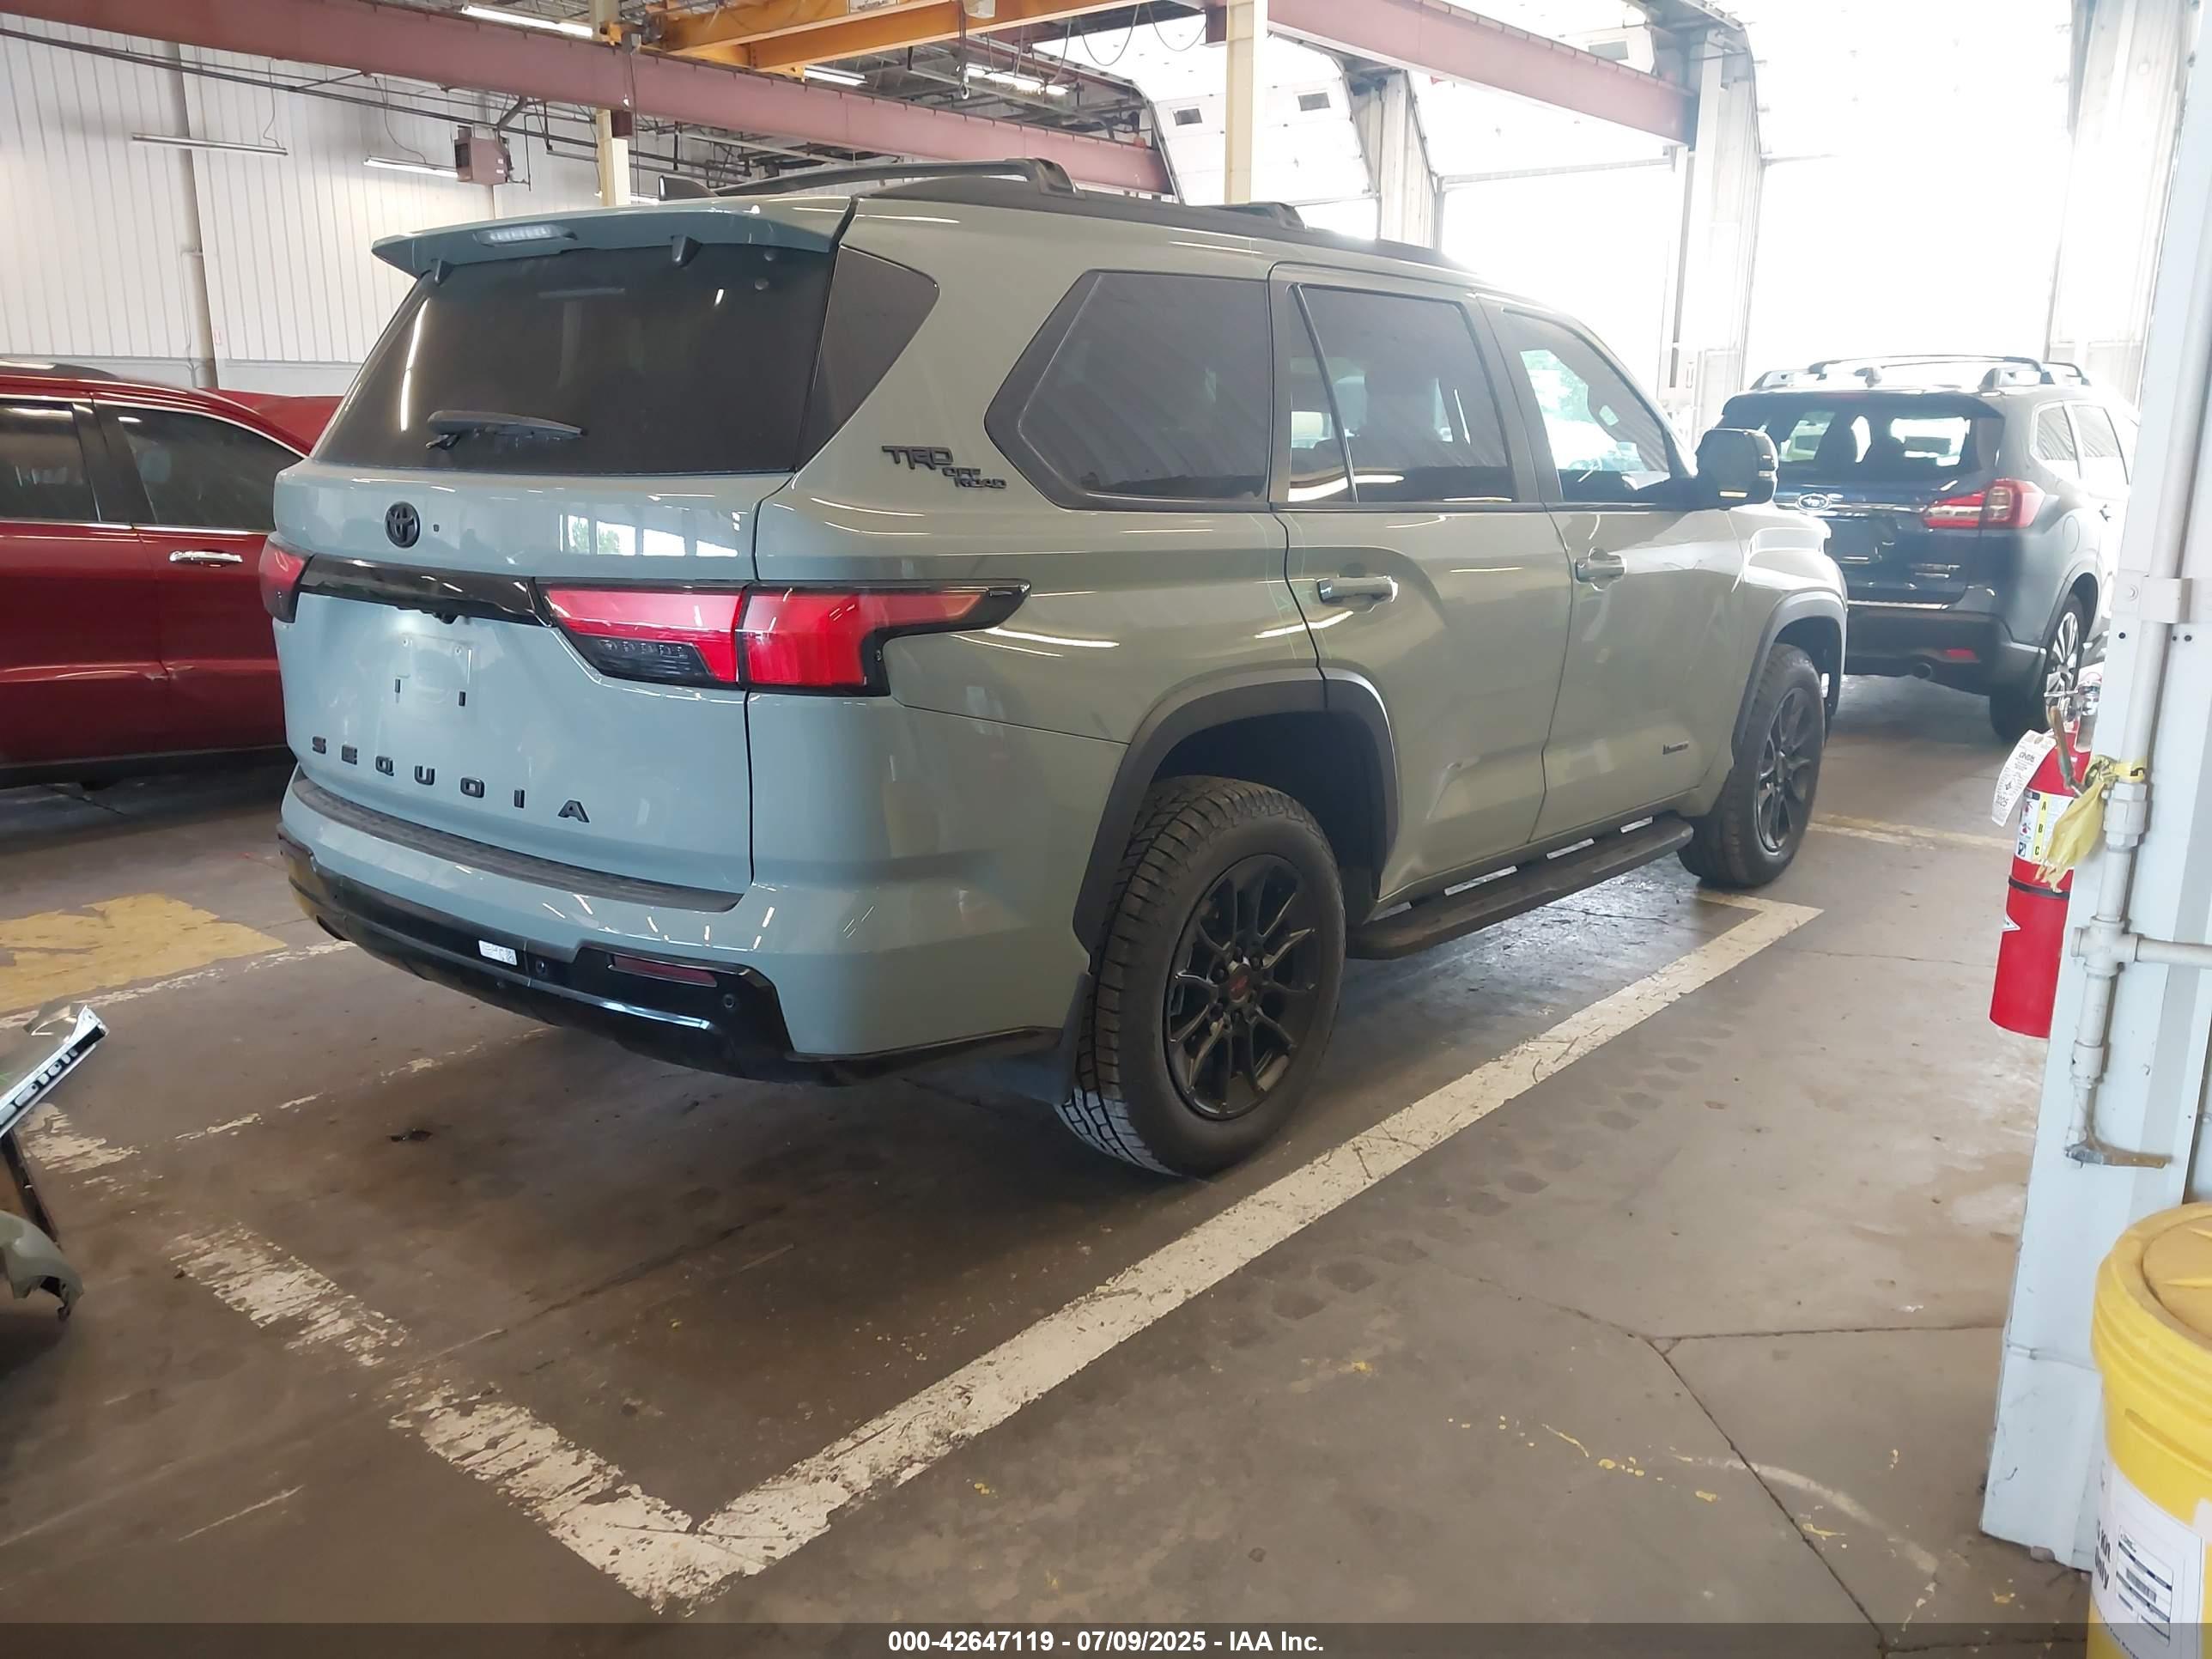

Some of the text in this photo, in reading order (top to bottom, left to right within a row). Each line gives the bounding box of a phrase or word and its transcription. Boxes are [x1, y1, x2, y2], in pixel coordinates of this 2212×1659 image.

[881, 446, 953, 470] TRD
[954, 477, 1006, 489] ROAD
[312, 736, 590, 823] SEQUOIA
[2041, 801, 2047, 811] A
[2038, 823, 2044, 833] B
[2034, 846, 2040, 856] C
